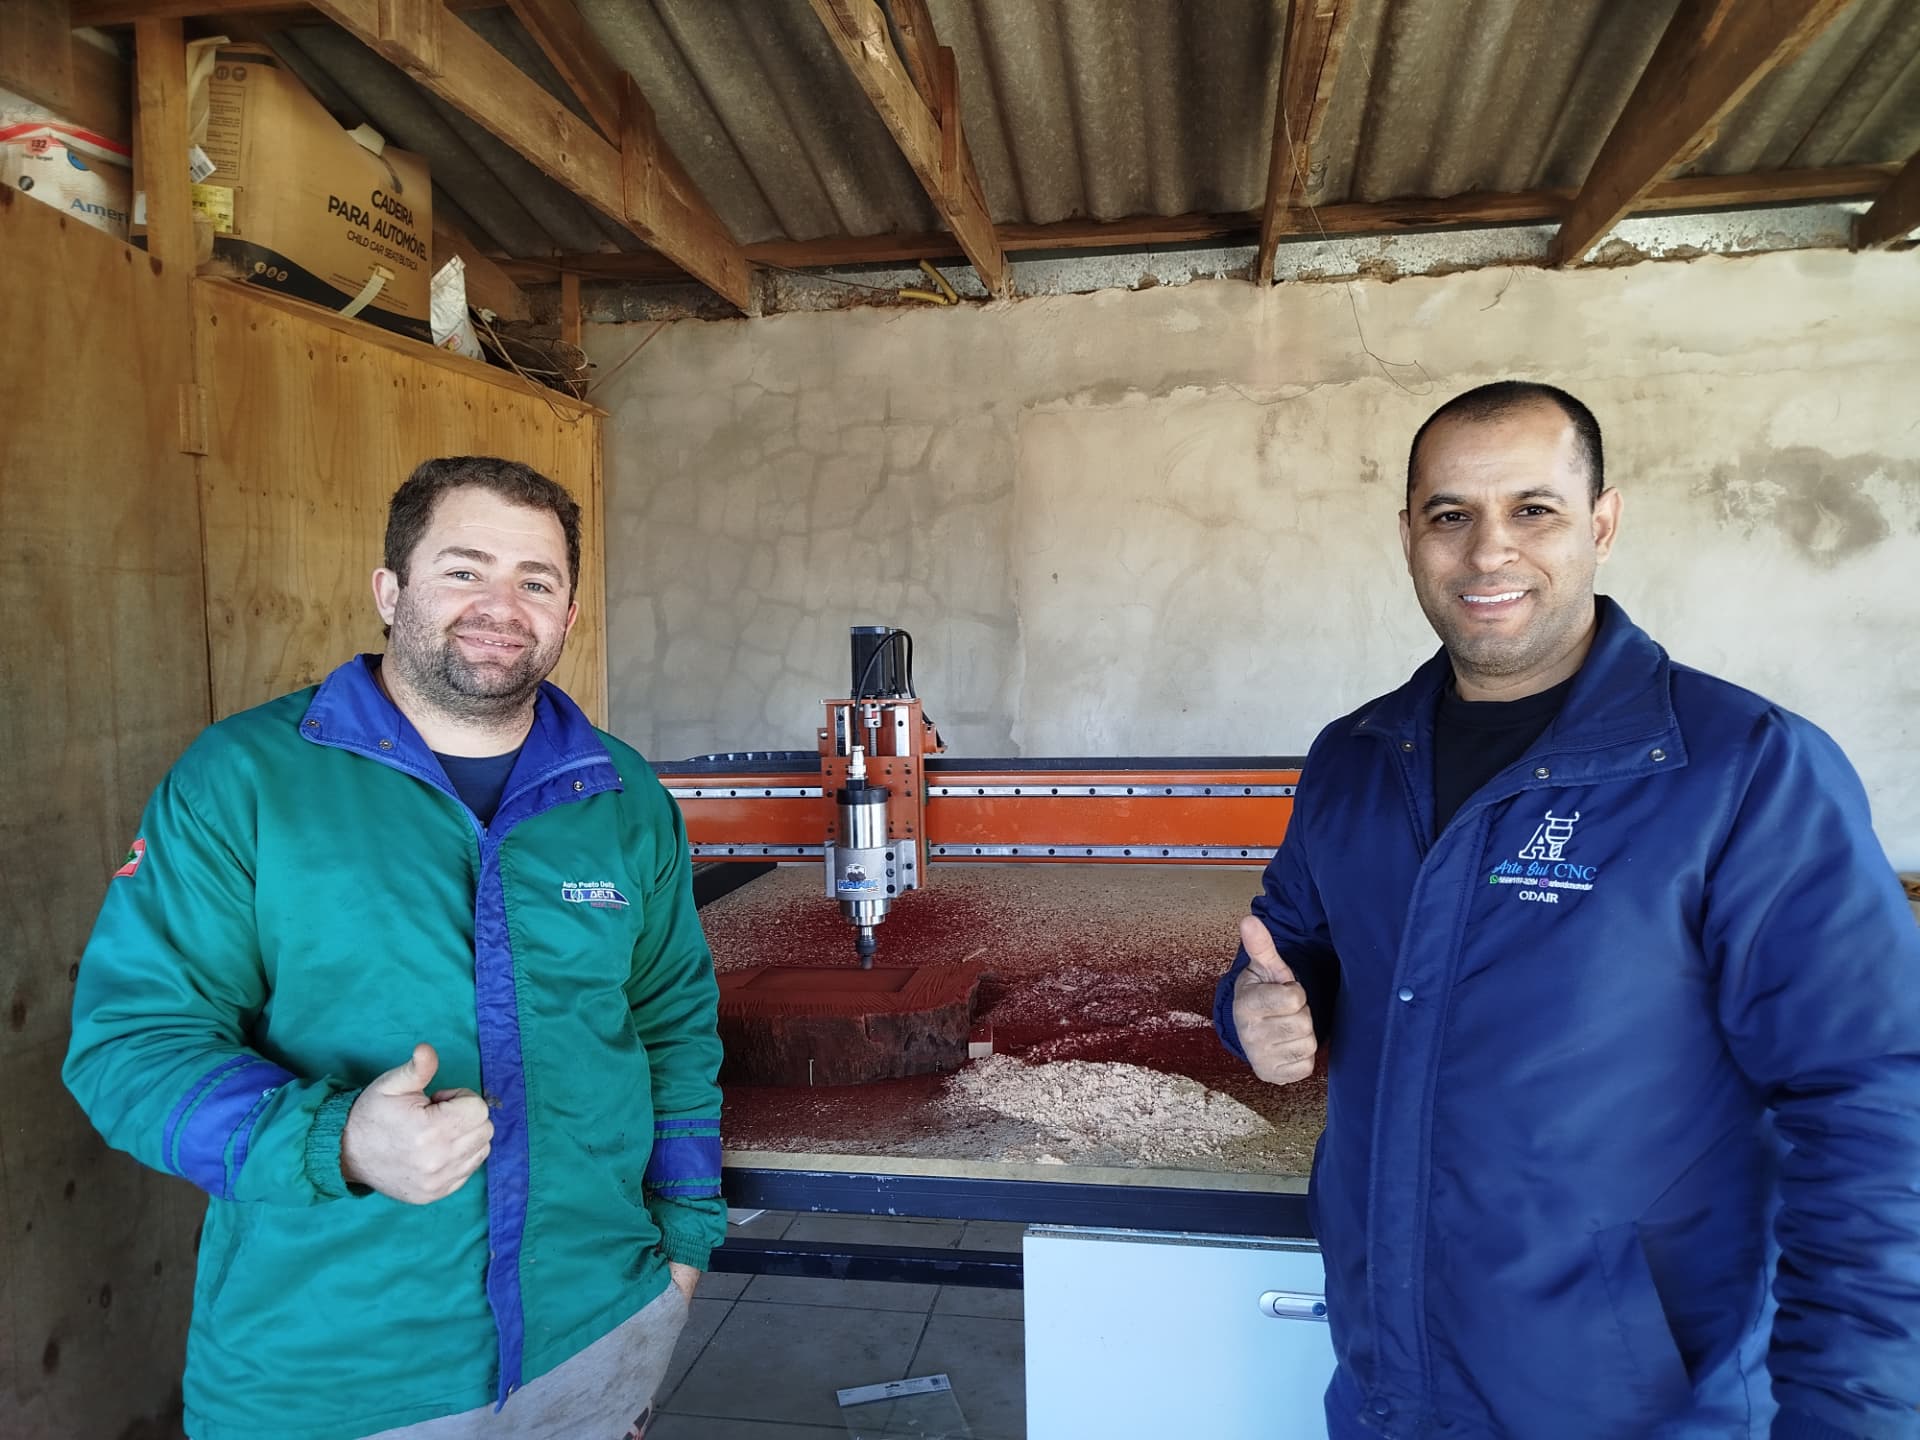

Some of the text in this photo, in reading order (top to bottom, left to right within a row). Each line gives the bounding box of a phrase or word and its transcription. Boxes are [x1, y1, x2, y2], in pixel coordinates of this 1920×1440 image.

[328, 195, 427, 261] PARA AUTOMÓVEL
[346, 230, 370, 248] CHILD
[369, 241, 385, 256] CAR
[1492, 860, 1596, 880] Arte Sul CNC
[1519, 891, 1558, 903] ODAIR
